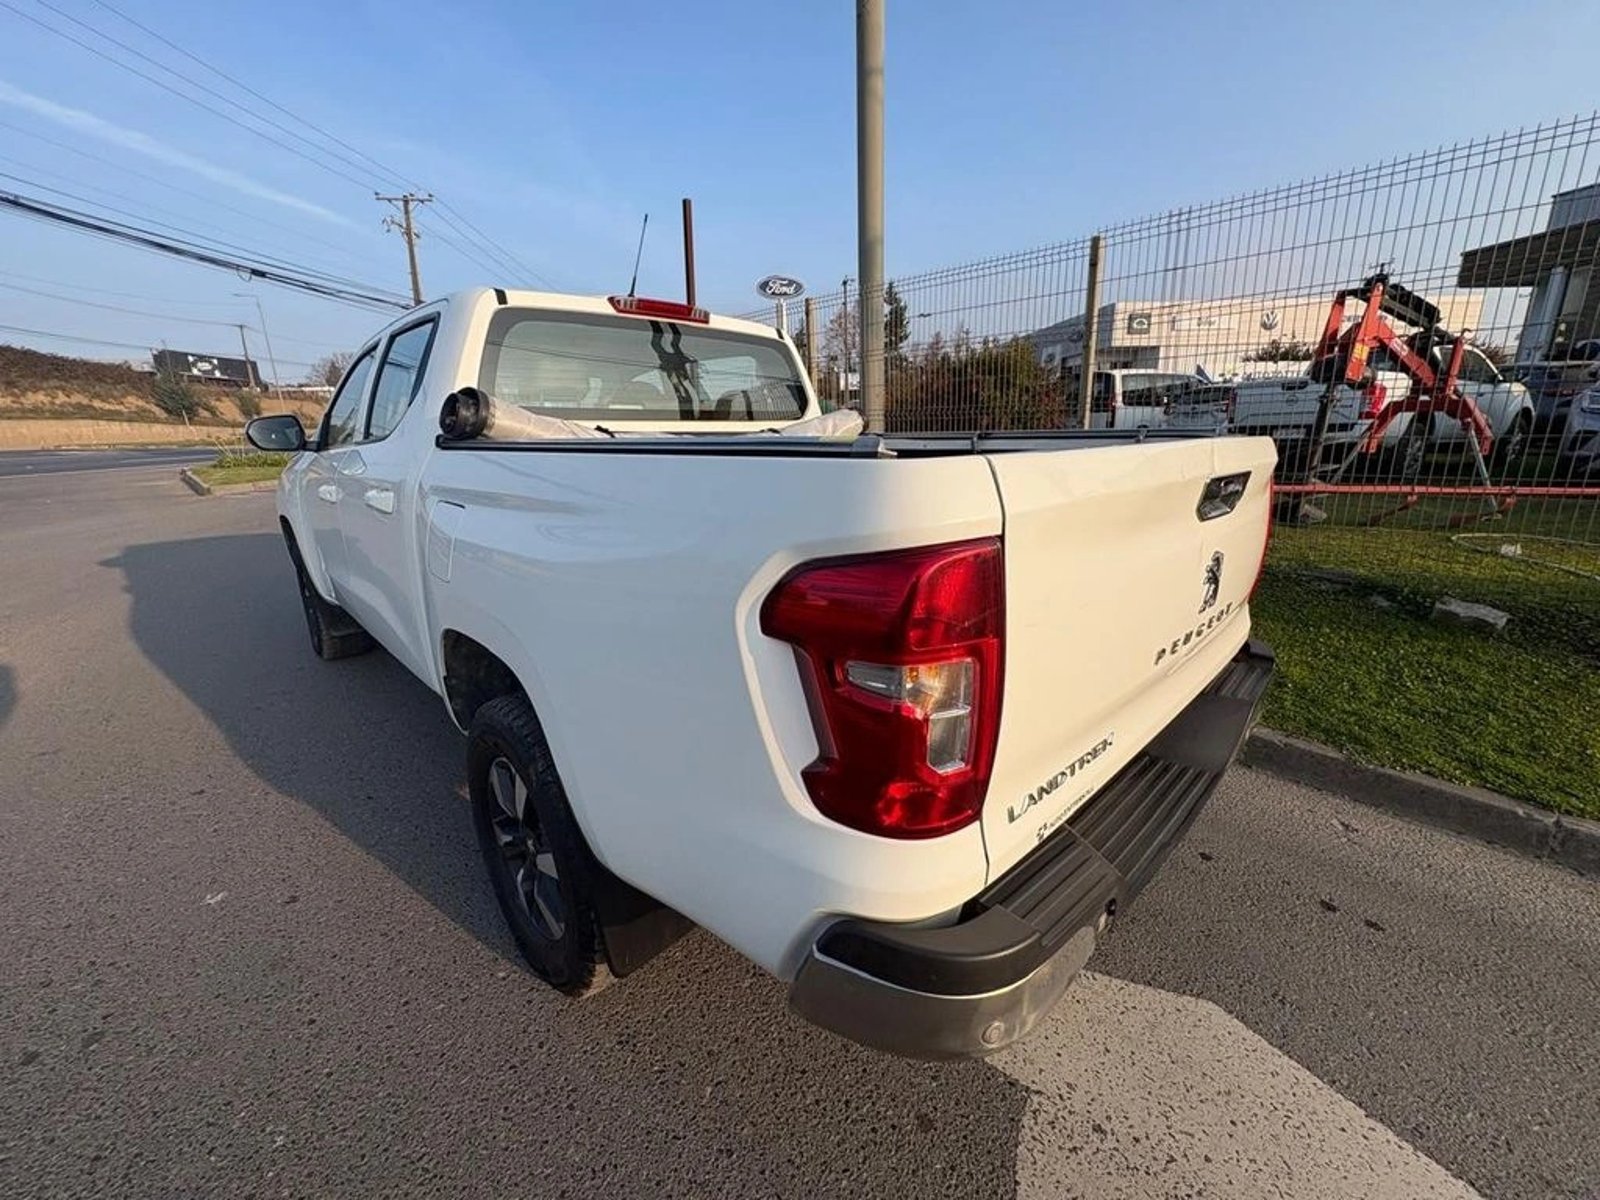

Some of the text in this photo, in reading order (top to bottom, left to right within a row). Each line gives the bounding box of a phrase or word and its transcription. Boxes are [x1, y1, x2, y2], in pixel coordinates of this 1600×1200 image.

[766, 279, 796, 295] Ford
[1154, 601, 1233, 665] PEUGEOT
[1007, 731, 1115, 824] LANDTREK
